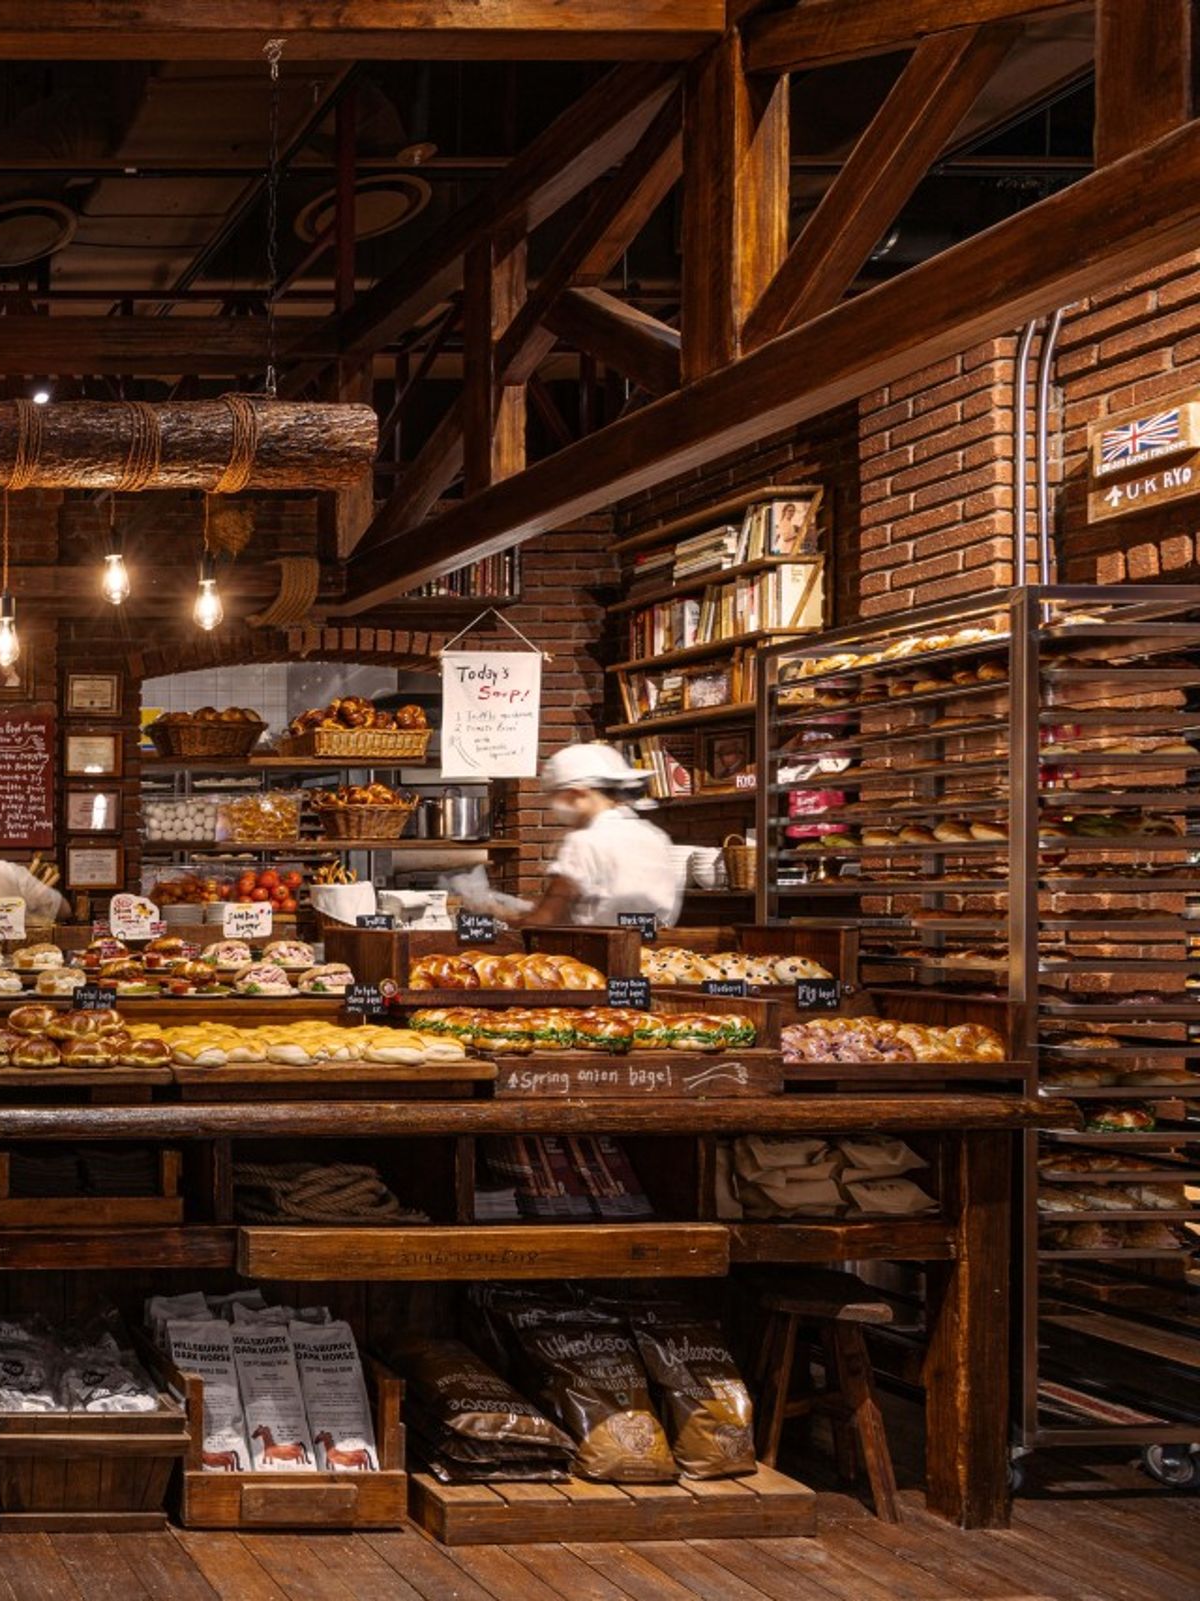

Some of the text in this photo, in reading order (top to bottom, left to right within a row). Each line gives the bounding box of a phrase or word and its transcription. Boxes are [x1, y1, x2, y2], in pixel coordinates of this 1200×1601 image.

[519, 1065, 672, 1094] Spring onion bagel
[173, 1350, 198, 1361] DARK
